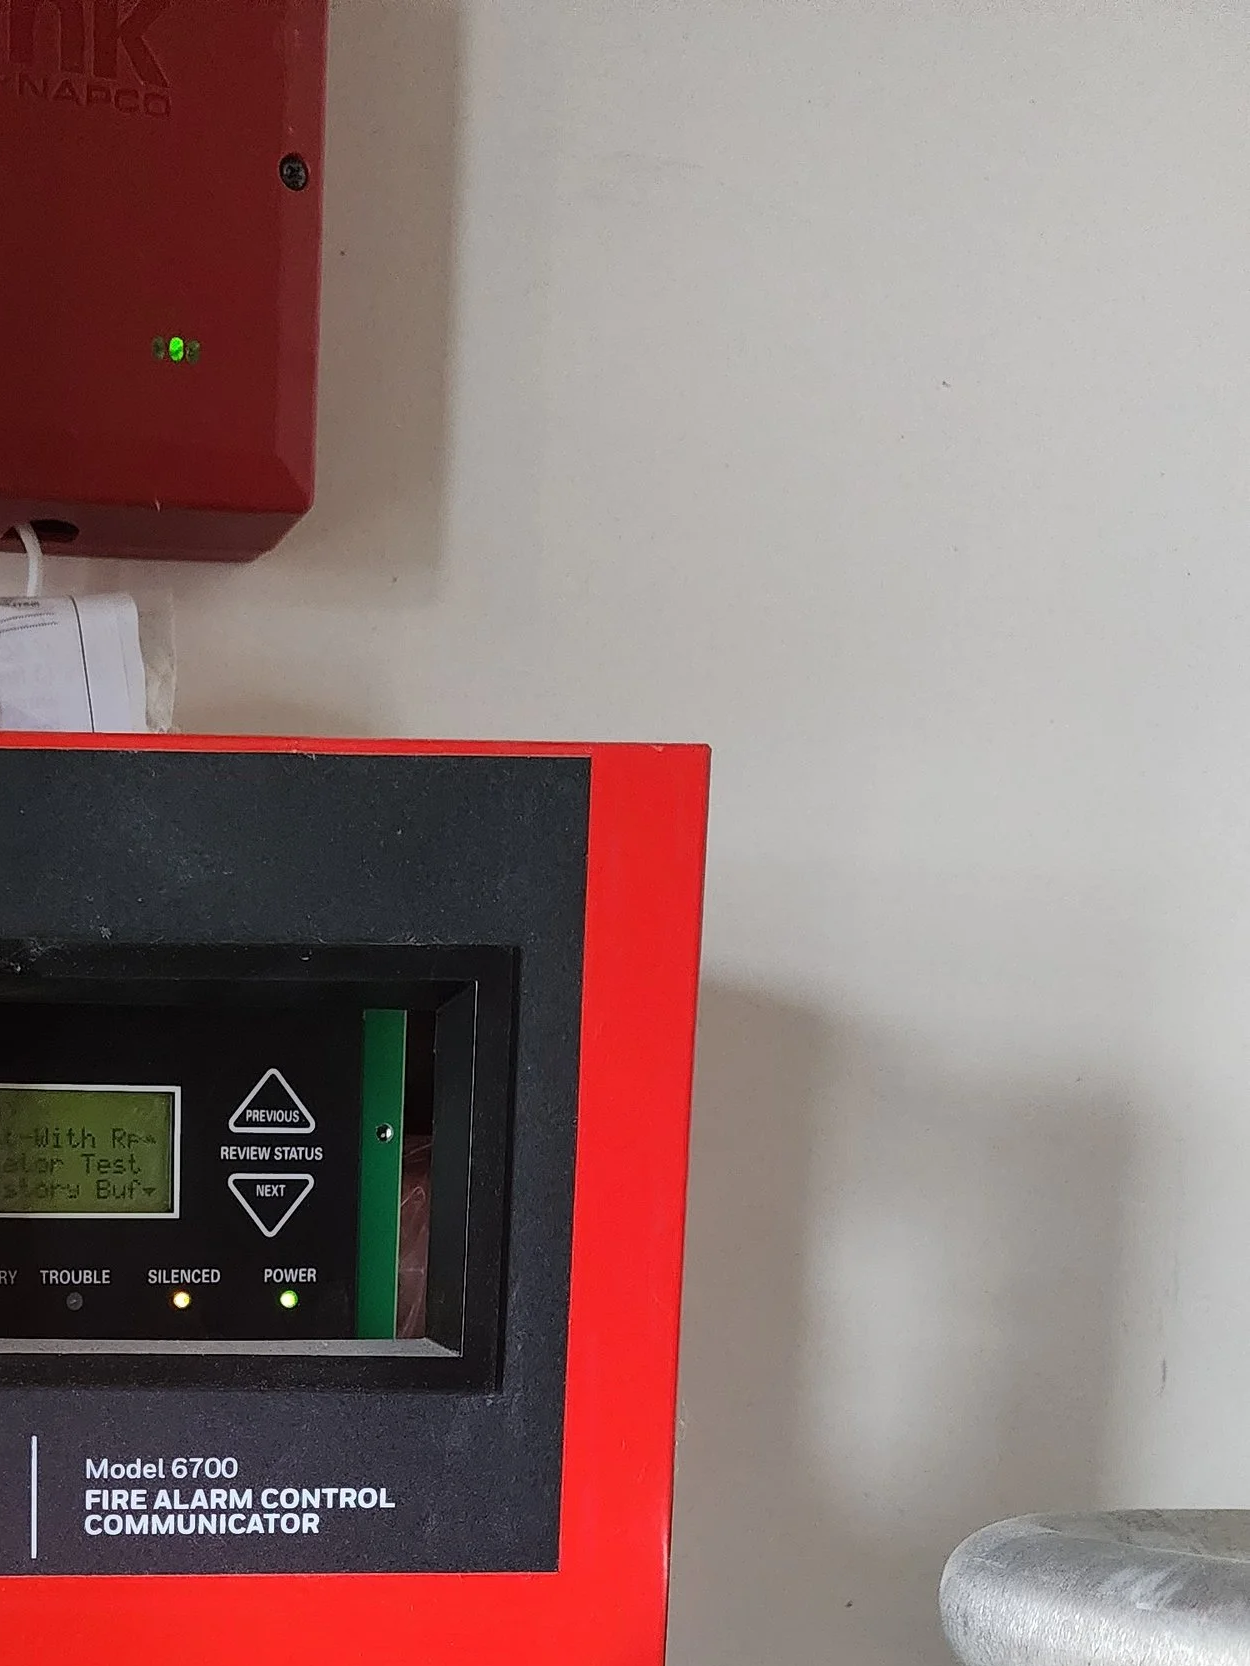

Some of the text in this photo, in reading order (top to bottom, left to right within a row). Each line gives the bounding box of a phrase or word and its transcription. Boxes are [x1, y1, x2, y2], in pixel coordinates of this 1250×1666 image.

[16, 73, 172, 118] NAPCO
[245, 1109, 300, 1123] PREVIOUS
[220, 1146, 323, 1161] REVIEW STATUS
[80, 1153, 142, 1175] Test
[95, 1179, 141, 1201] Buf
[255, 1184, 286, 1197] NEXT
[39, 1269, 111, 1286] TROUBLE
[147, 1268, 221, 1285] SILENCED
[263, 1267, 317, 1284] POWER
[85, 1457, 238, 1479] Model 6700
[85, 1487, 396, 1510] FIRE ALARM CONTROL
[84, 1512, 320, 1536] COMMUNICATOR
